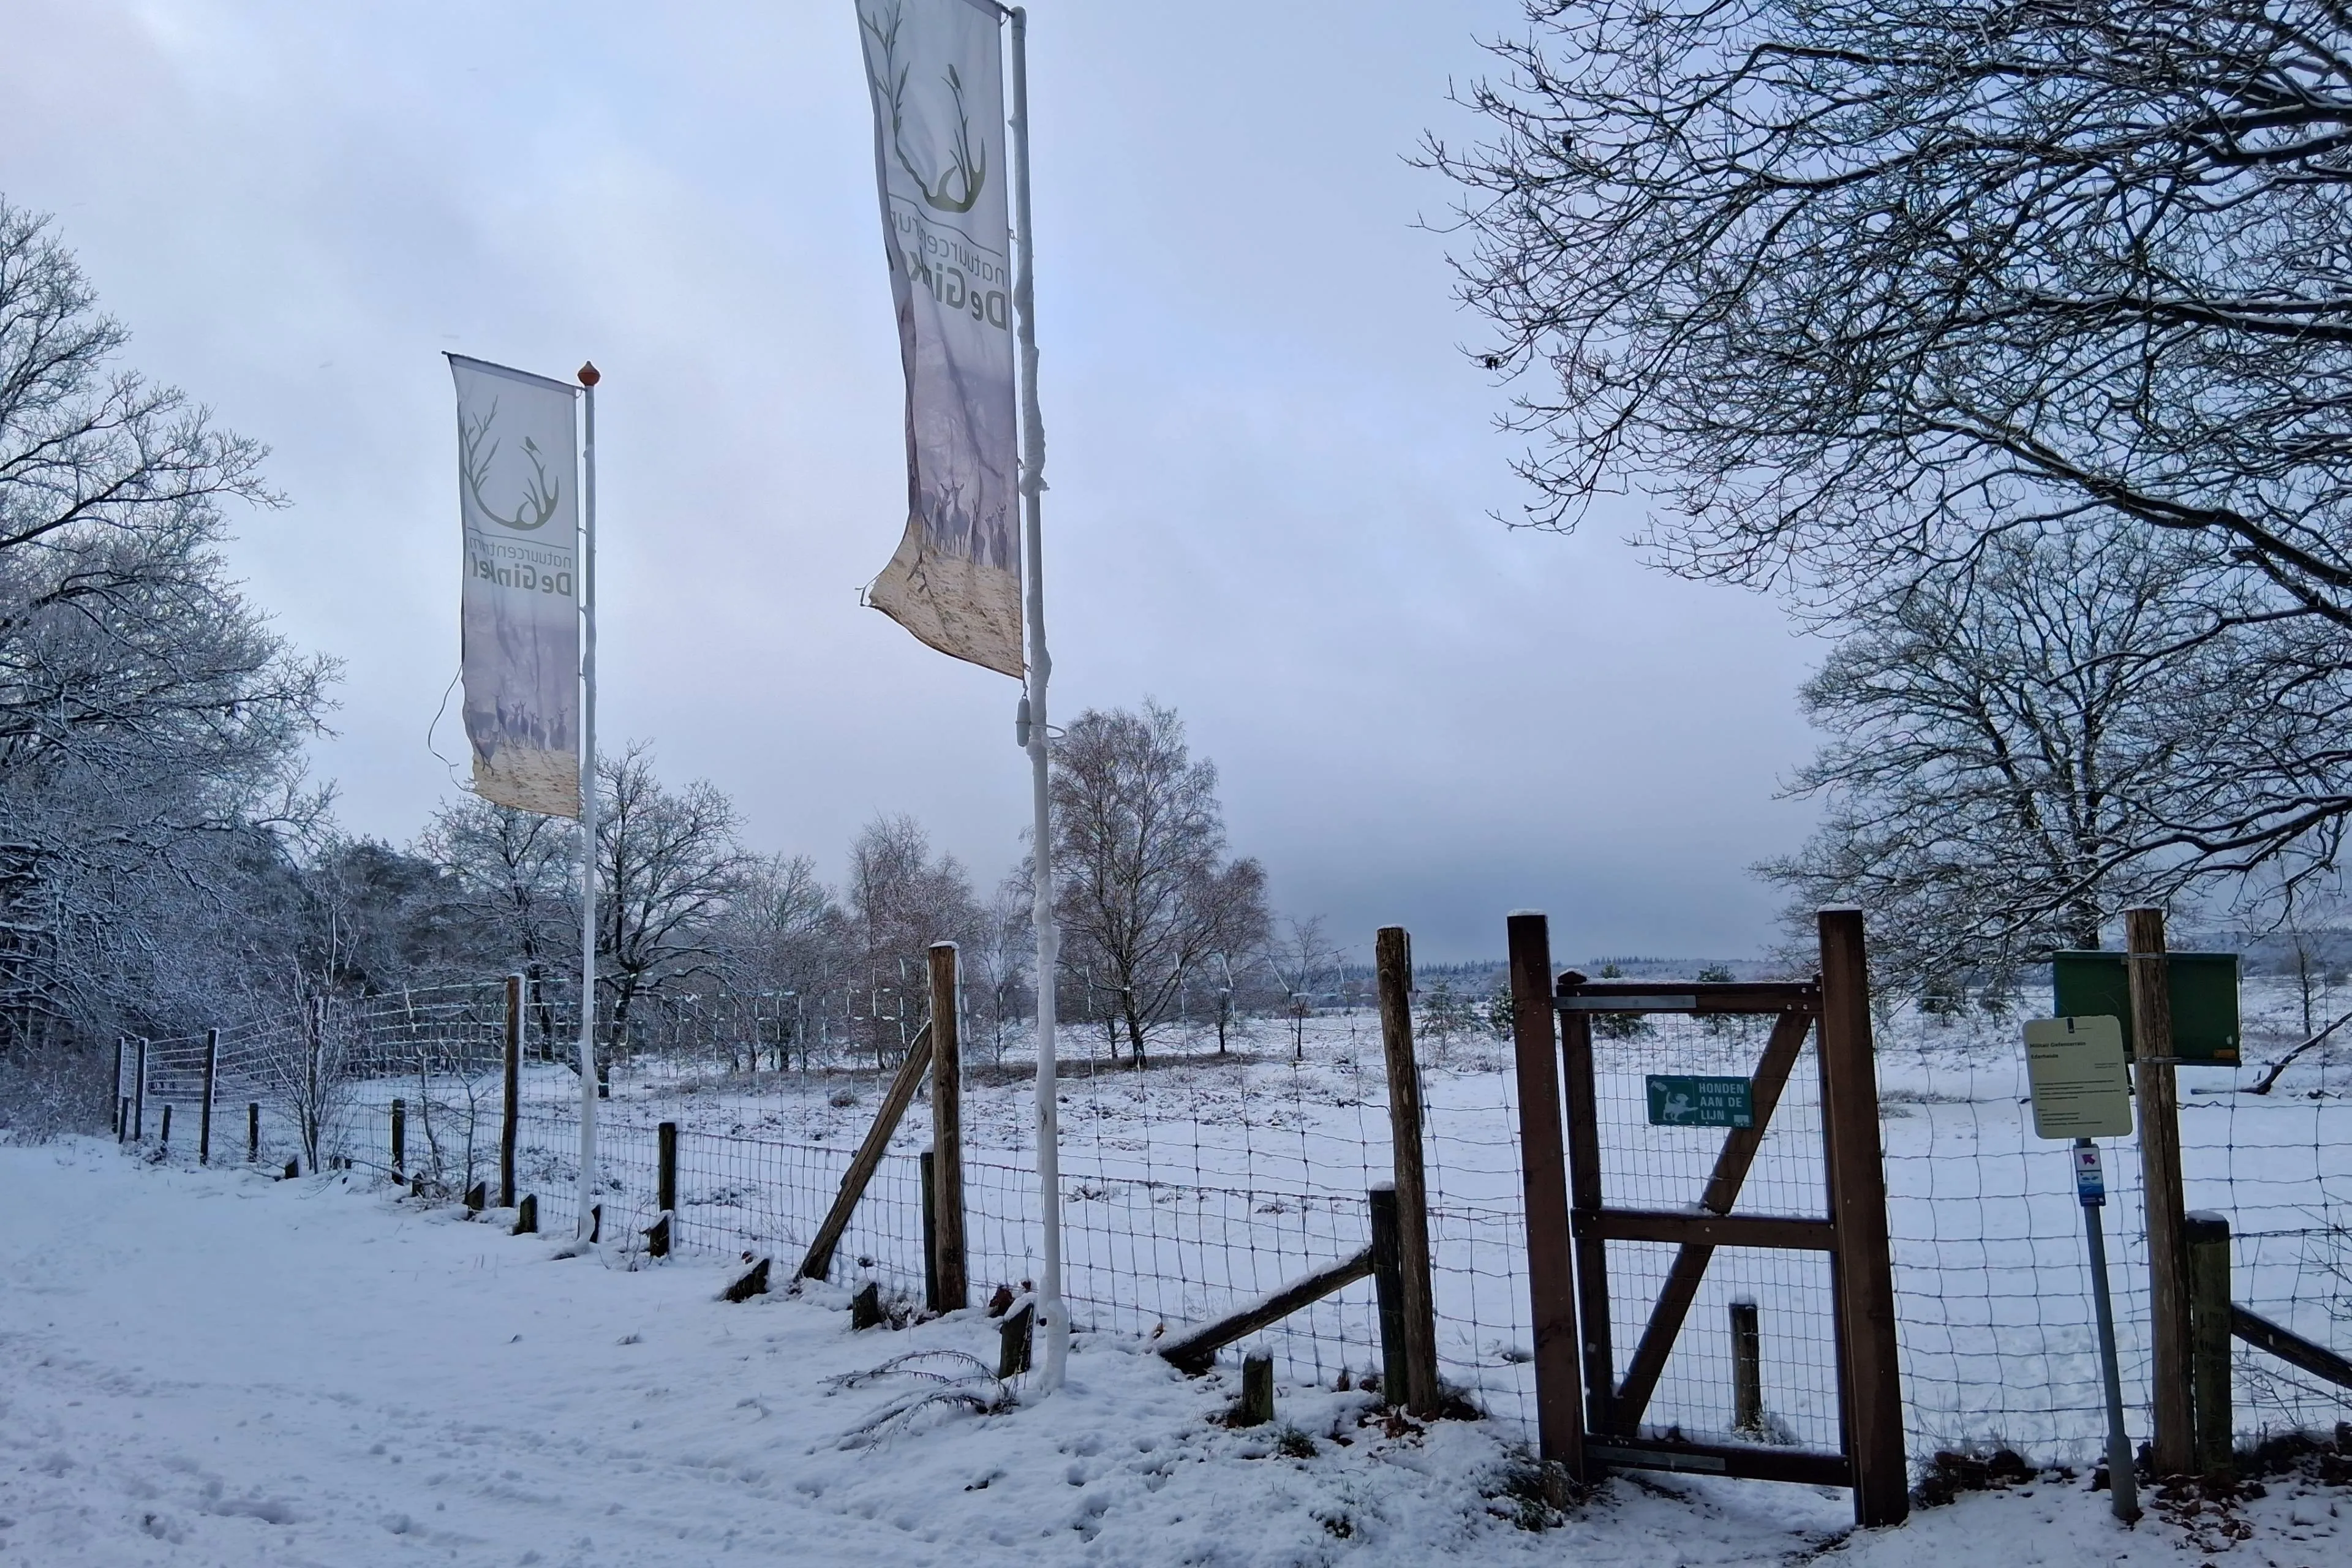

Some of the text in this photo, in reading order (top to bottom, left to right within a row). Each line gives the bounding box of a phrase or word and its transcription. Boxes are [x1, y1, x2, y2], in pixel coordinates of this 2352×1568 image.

[1698, 1082, 1744, 1094] HONDEN
[1700, 1097, 1743, 1107] AAN DE
[1700, 1110, 1725, 1120] LIJN
